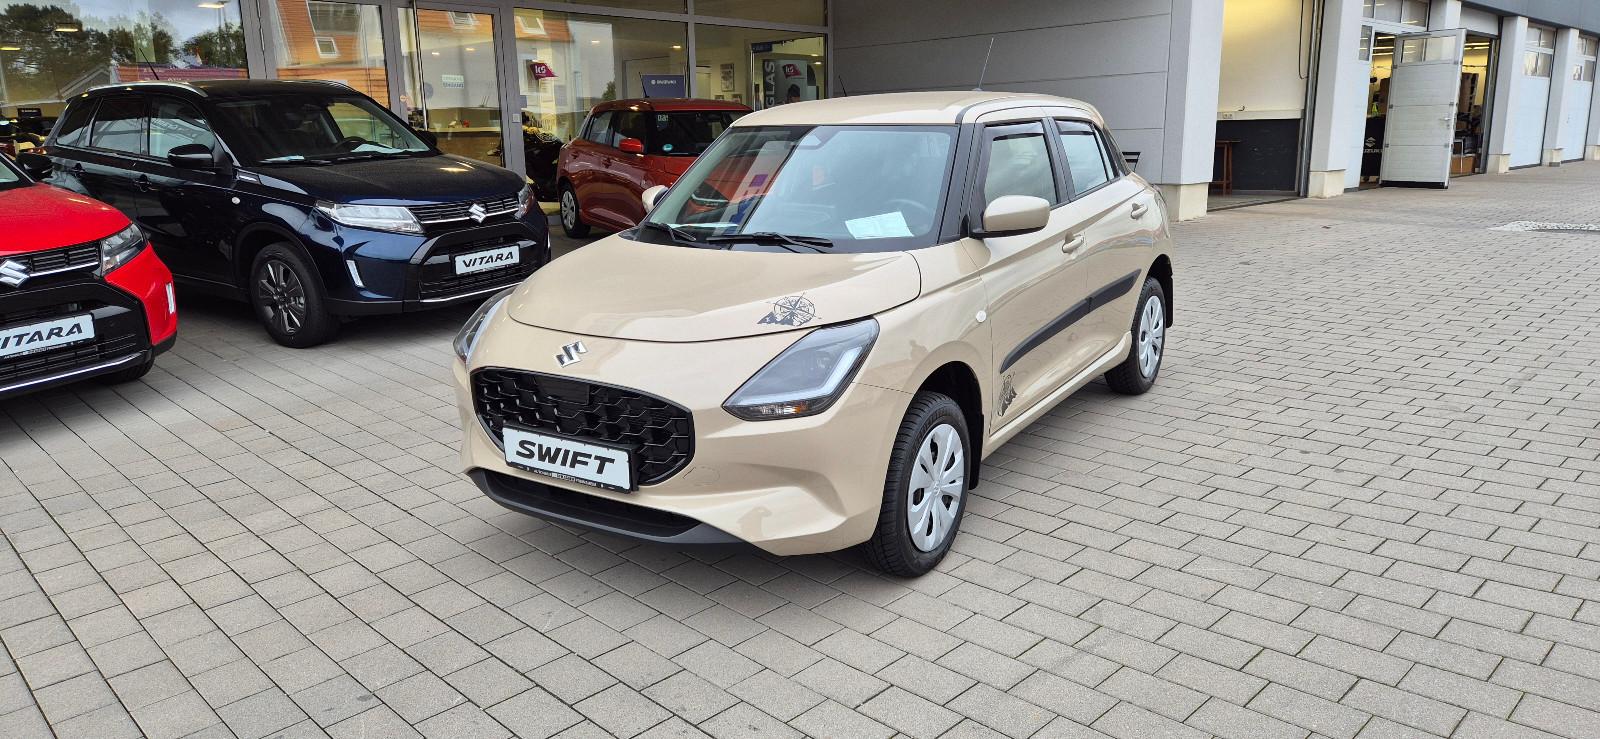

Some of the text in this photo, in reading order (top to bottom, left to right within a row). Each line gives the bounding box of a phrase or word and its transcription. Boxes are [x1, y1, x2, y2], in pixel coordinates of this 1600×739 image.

[463, 251, 514, 268] VITARA
[0, 323, 82, 349] ITARA
[516, 439, 616, 476] SWIFT
